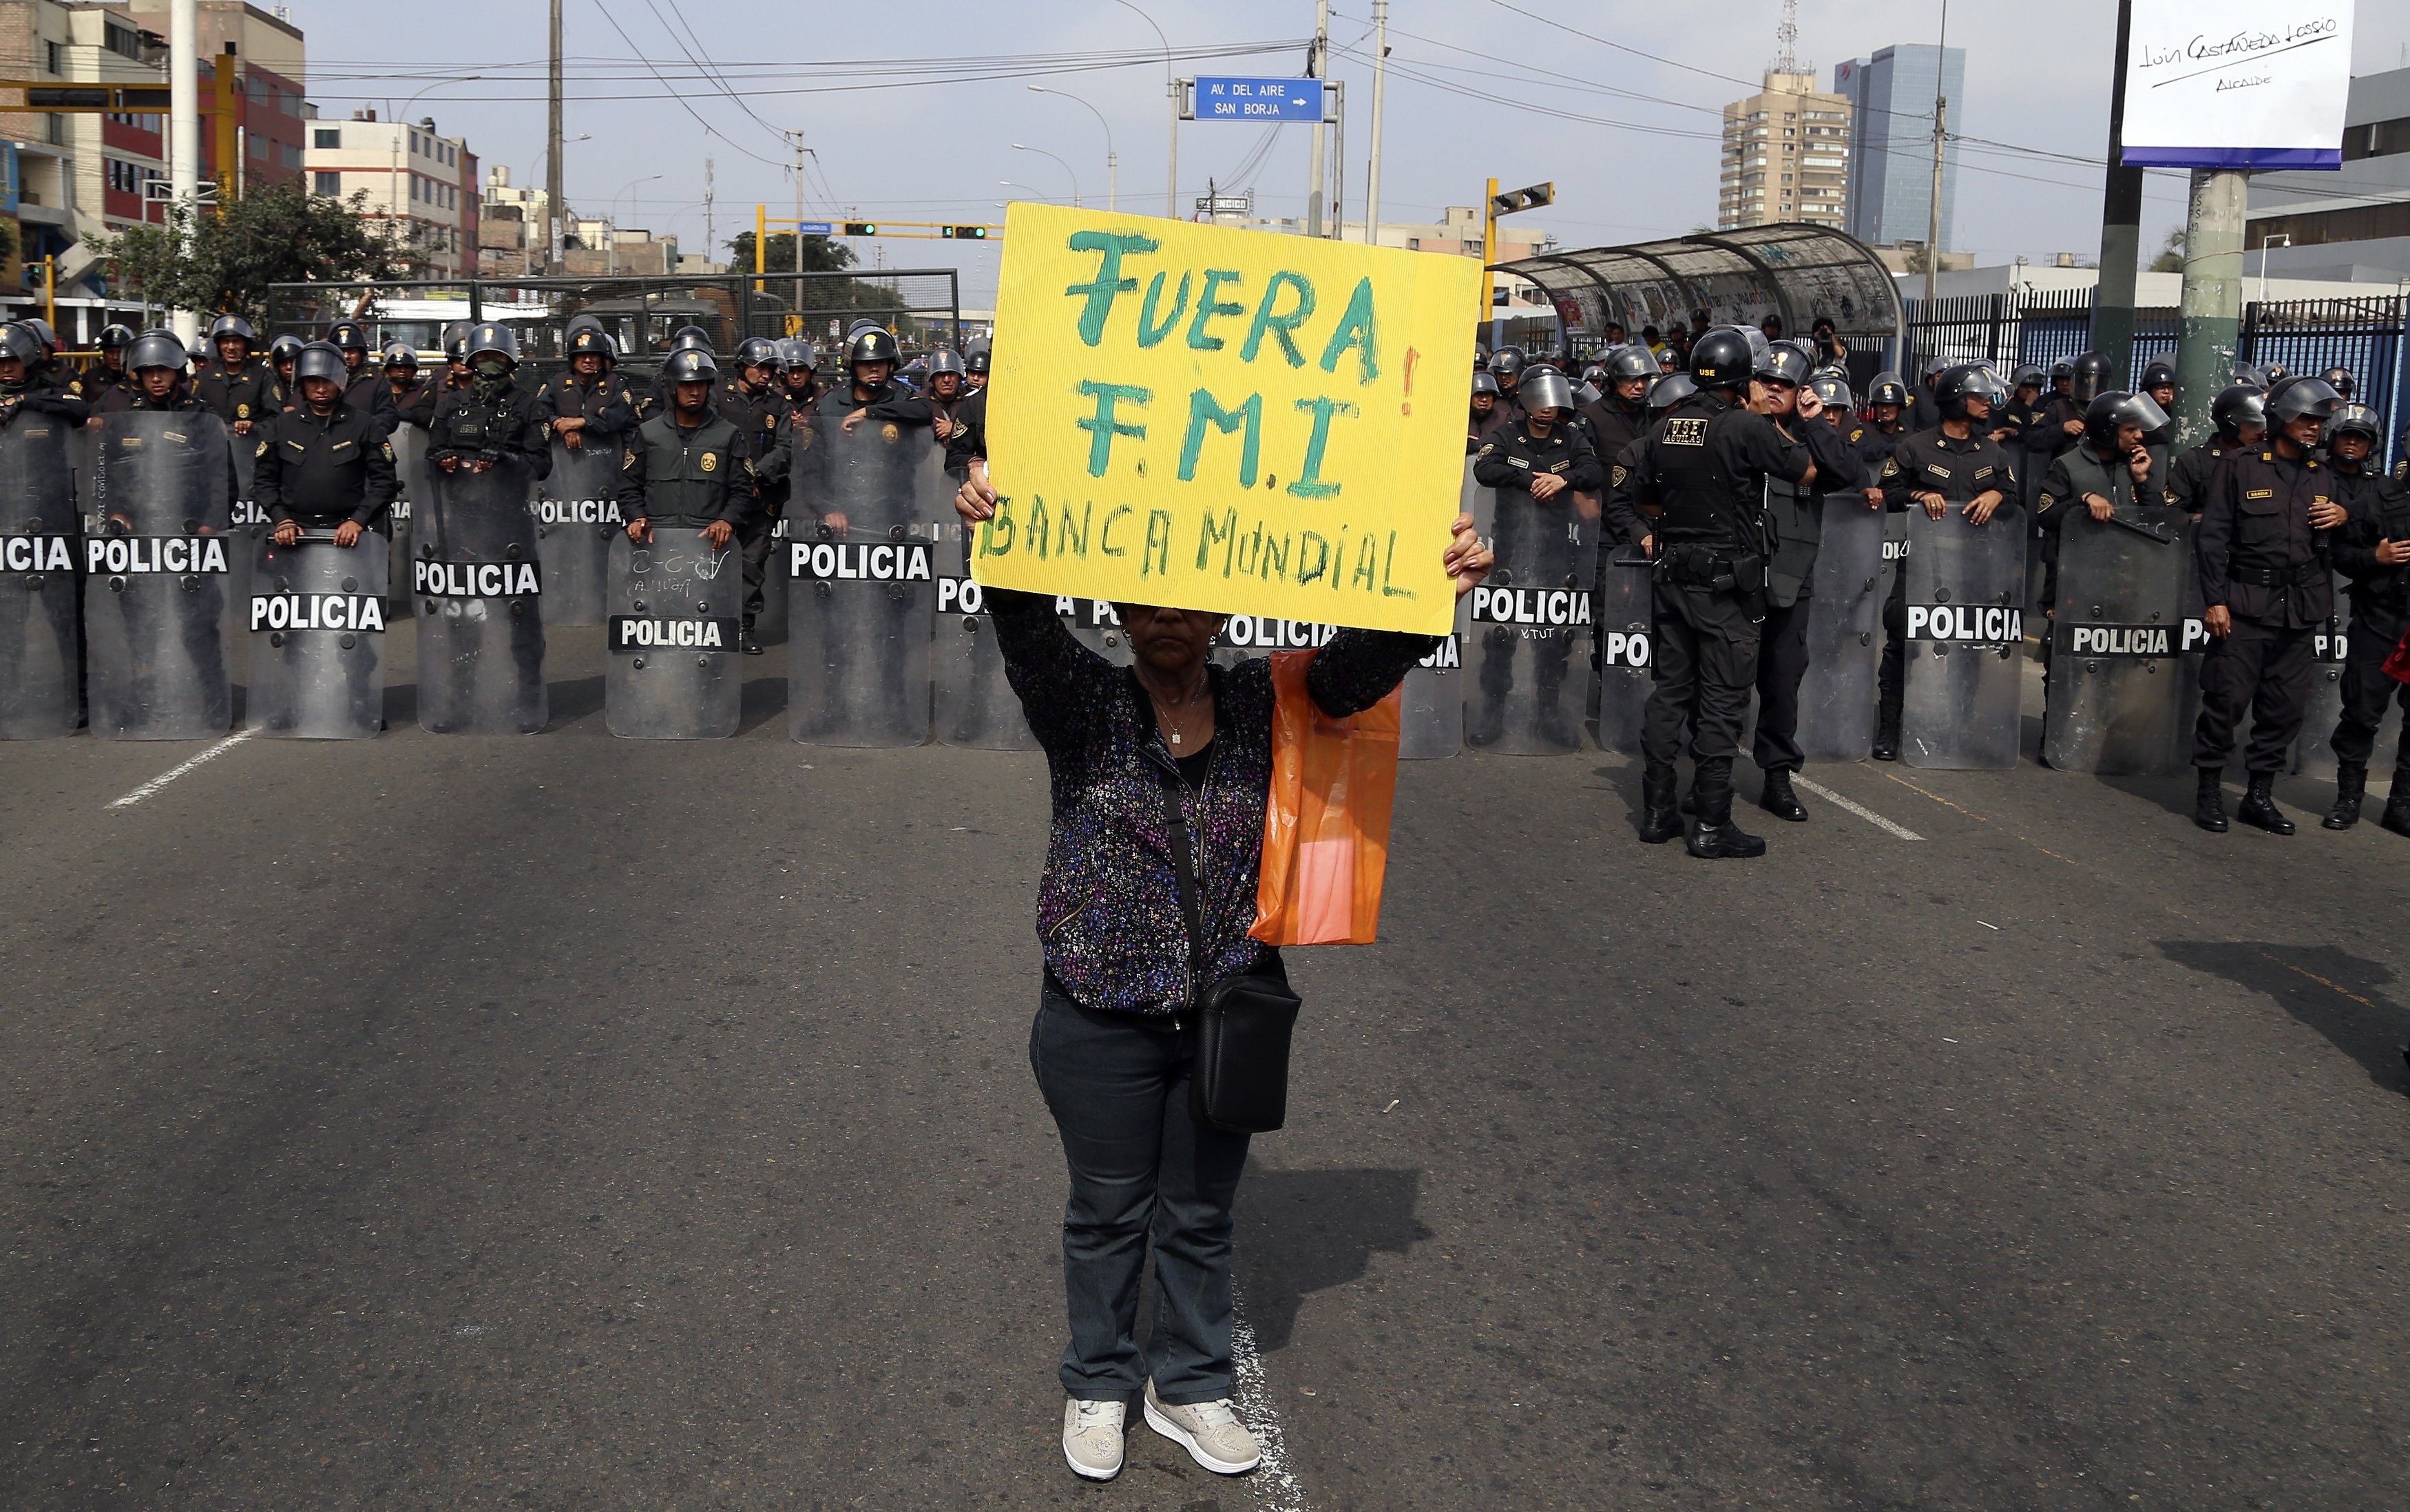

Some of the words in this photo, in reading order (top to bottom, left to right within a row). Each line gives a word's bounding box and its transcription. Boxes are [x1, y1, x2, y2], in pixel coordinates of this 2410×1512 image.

[1211, 84, 1225, 95] AV.
[1233, 84, 1253, 96] DEL
[1259, 85, 1285, 96] AIRE
[1215, 103, 1236, 114] SAN
[1244, 103, 1280, 115] BORJA
[1065, 229, 1381, 386] FUERA
[1664, 434, 1701, 444] AGUILAS
[1671, 420, 1700, 435] USE
[979, 494, 1172, 581] BANCA
[88, 538, 227, 573] POLICIA
[791, 543, 930, 580] POLICIA
[415, 561, 538, 596] POLICIA
[251, 596, 384, 631] POLICIA
[1473, 587, 1591, 624] POLICIA
[622, 620, 722, 647] POLICIA
[1222, 613, 1339, 647] OLICIA
[1907, 606, 2022, 641] POLICIA
[2073, 627, 2168, 653] POLICIA
